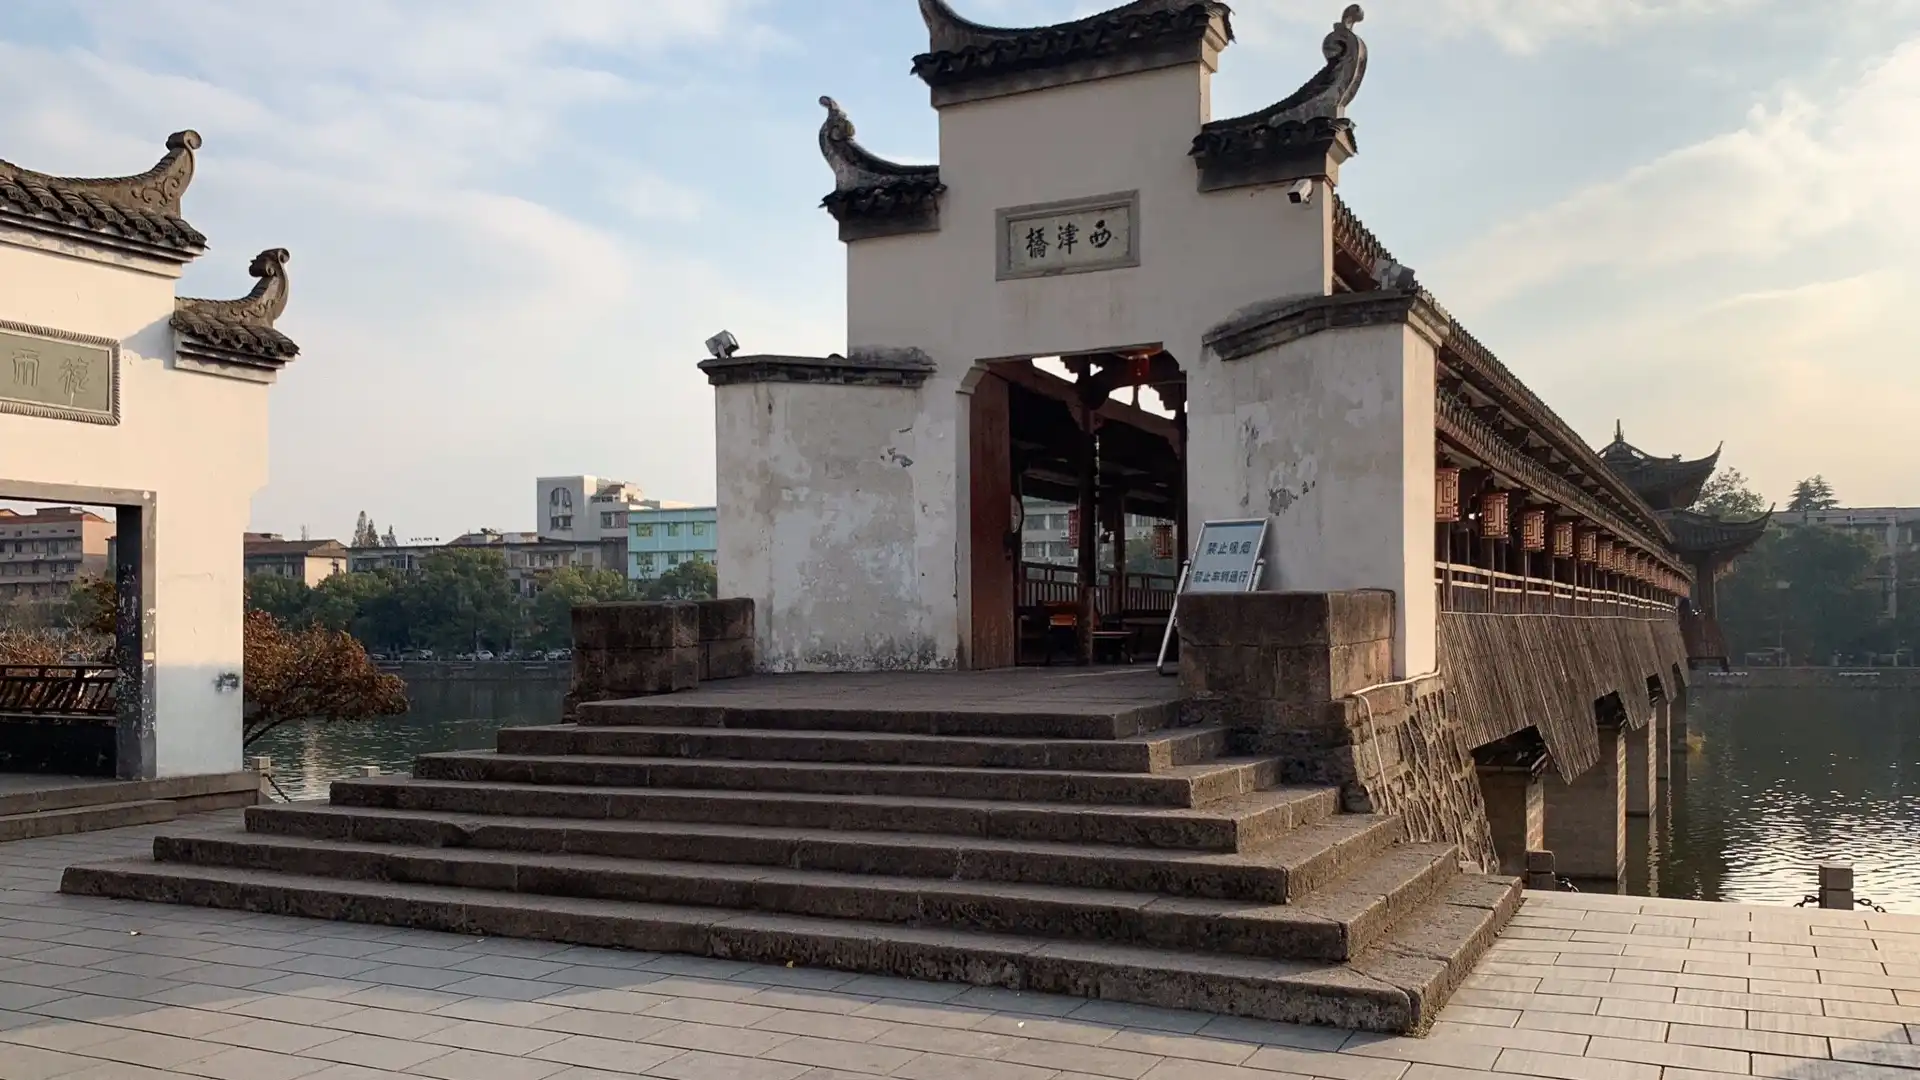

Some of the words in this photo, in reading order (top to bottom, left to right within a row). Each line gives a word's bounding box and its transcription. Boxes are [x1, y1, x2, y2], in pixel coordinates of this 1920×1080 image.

[1206, 540, 1252, 555] 禁止吸烟
[1193, 570, 1249, 584] 禁止车辆通行
